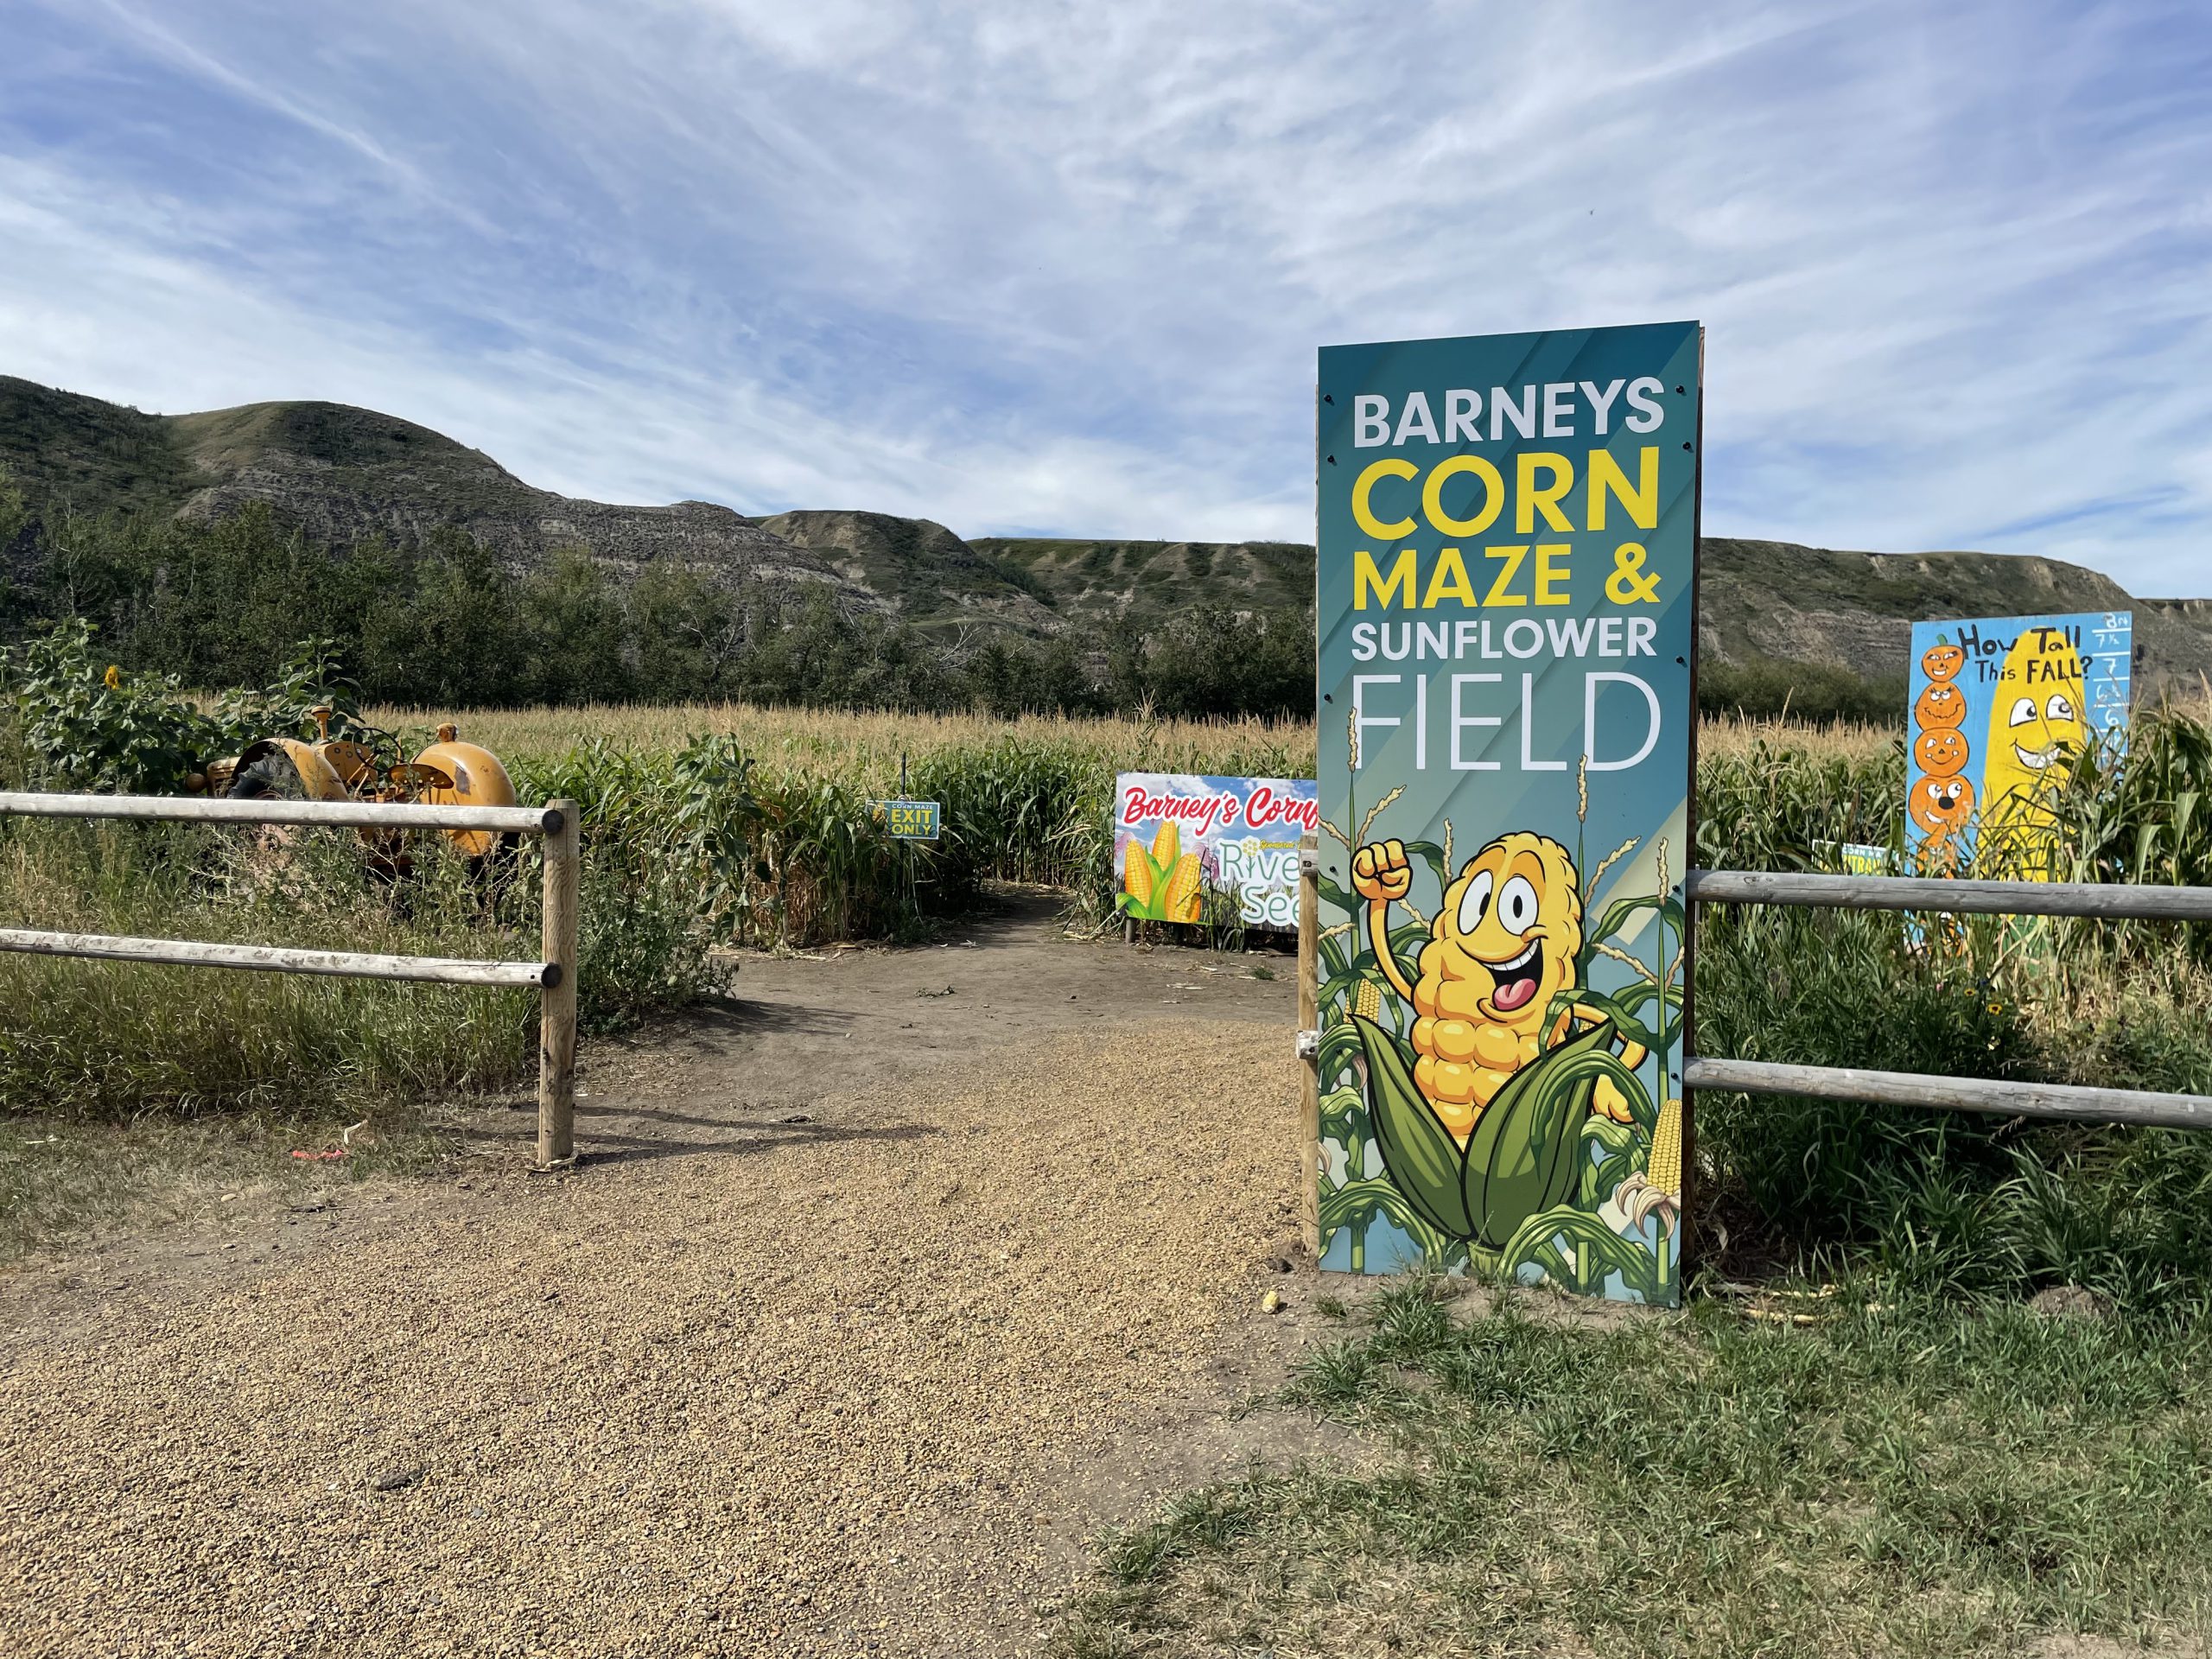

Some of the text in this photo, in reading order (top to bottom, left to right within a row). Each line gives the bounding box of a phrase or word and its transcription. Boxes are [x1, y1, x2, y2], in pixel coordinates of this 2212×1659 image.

[1354, 377, 1664, 448] BARNEYS
[1351, 446, 1659, 541] CORN
[1353, 542, 1662, 611] MAZE &
[1351, 616, 1657, 661] SUNFLOWER
[1957, 624, 2081, 659] How Tall
[1974, 655, 2093, 684] This FALL?
[2102, 658, 2117, 674] 7
[1352, 671, 1662, 772] FIELD
[2105, 709, 2120, 726] 6
[891, 809, 932, 824] EXIT
[891, 823, 931, 836] ONLY
[1124, 786, 1239, 836] Barney's
